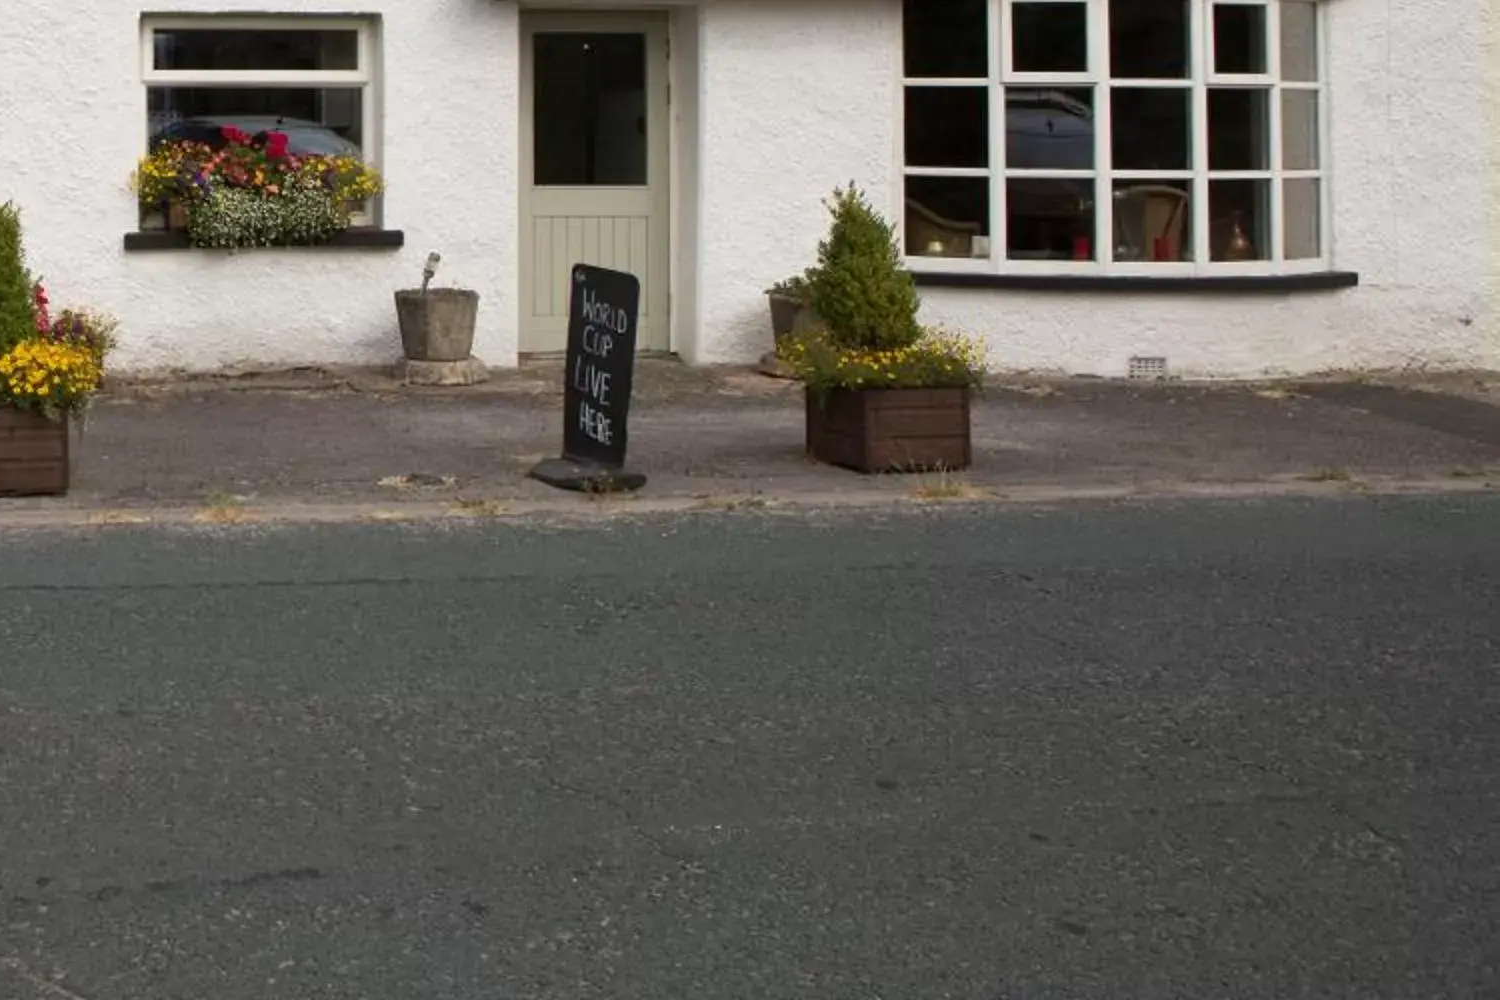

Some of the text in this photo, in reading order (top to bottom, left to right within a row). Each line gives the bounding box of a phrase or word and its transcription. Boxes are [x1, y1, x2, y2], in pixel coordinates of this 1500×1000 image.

[582, 287, 627, 334] WORLD
[582, 325, 613, 358] CUP
[574, 355, 612, 406] LIVE
[580, 400, 613, 446] HERE
